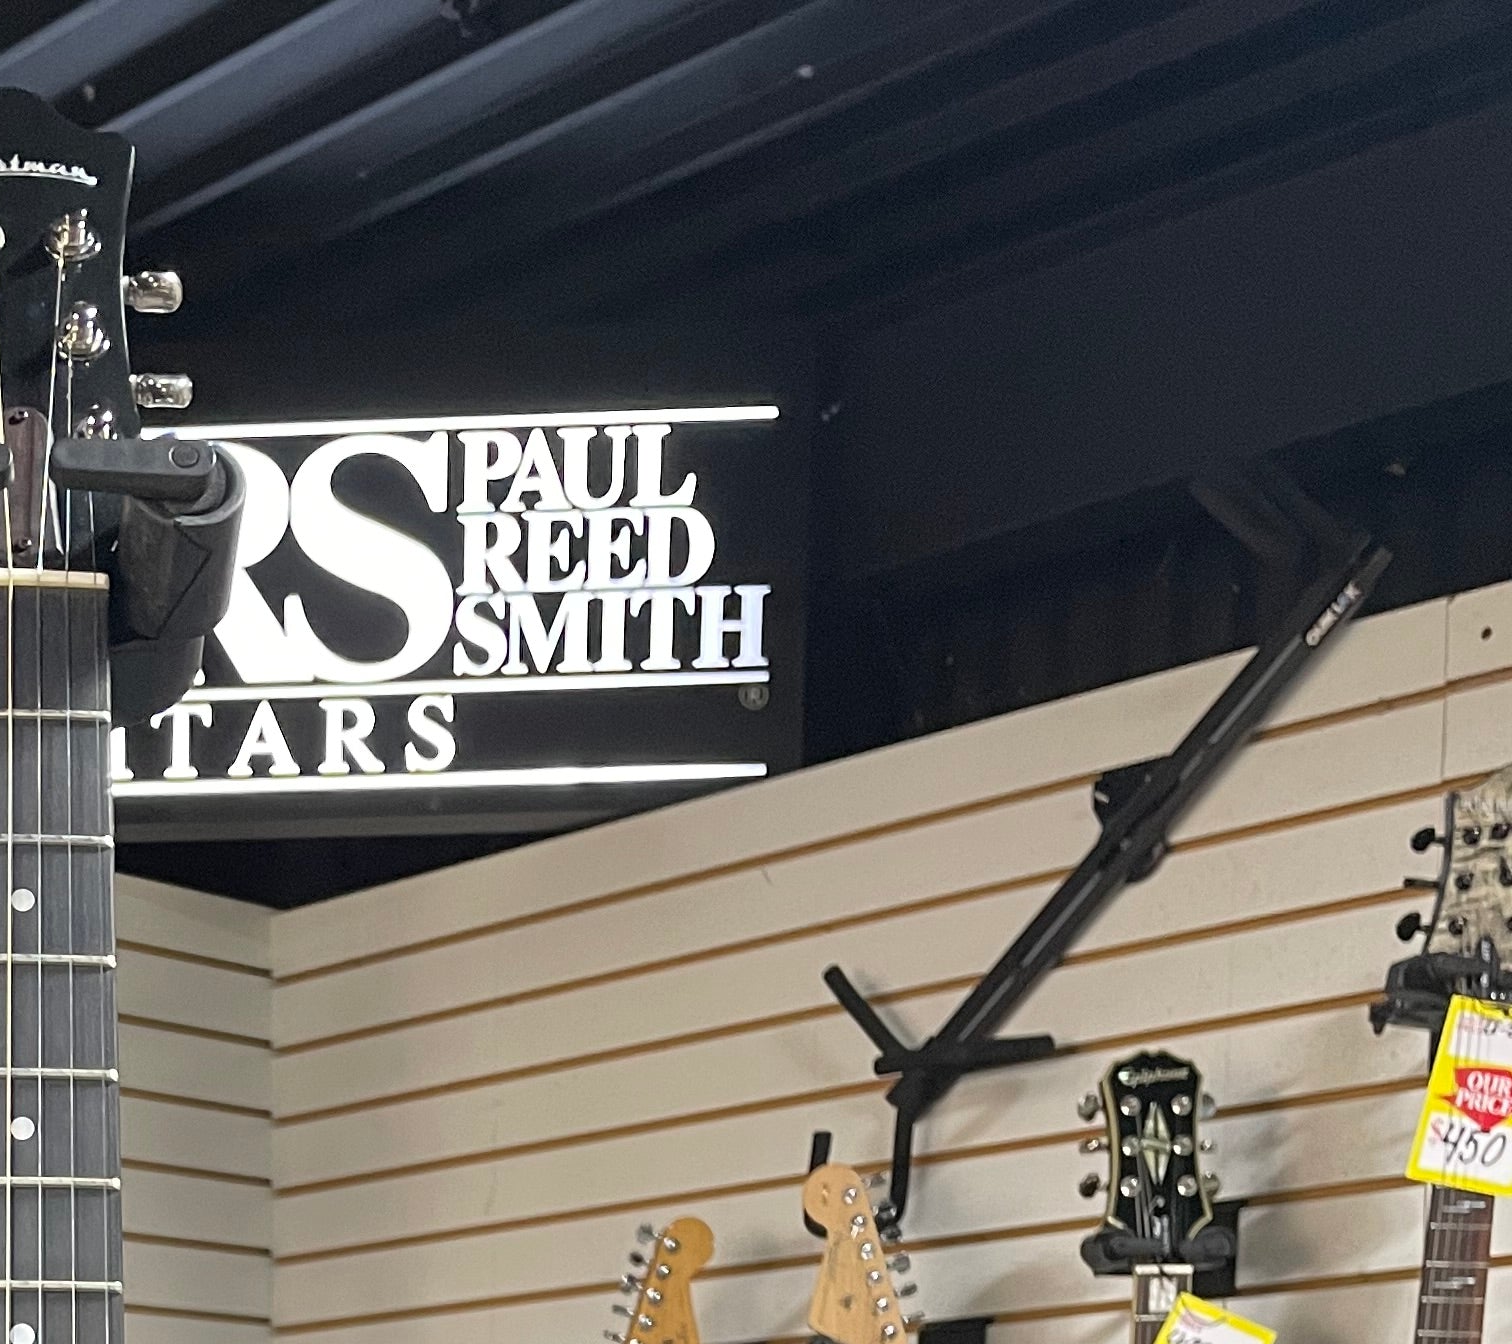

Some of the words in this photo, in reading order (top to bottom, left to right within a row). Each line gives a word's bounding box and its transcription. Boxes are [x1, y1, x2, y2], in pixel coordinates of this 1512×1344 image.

[456, 424, 697, 512] PAUL
[191, 430, 454, 686] RS
[457, 508, 716, 596] REED
[452, 584, 772, 677] SMITH
[1466, 1070, 1512, 1098] OUR
